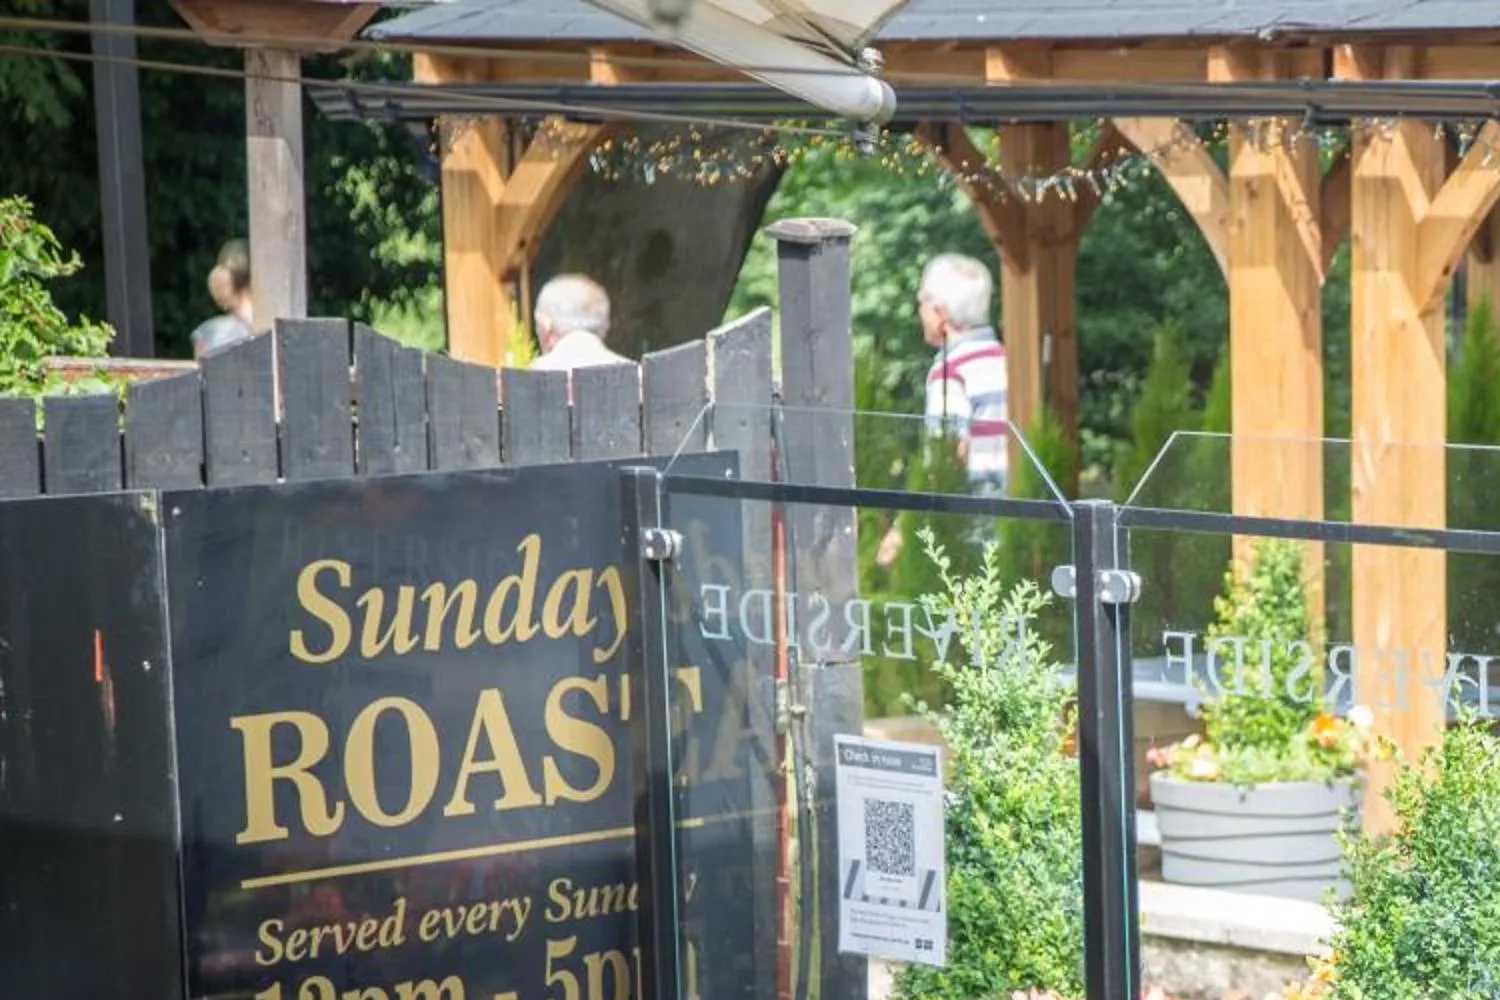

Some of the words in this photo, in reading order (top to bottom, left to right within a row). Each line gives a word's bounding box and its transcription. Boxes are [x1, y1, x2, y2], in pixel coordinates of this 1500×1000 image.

[289, 534, 629, 663] Sunday
[255, 897, 407, 967] Served
[418, 895, 531, 941] every
